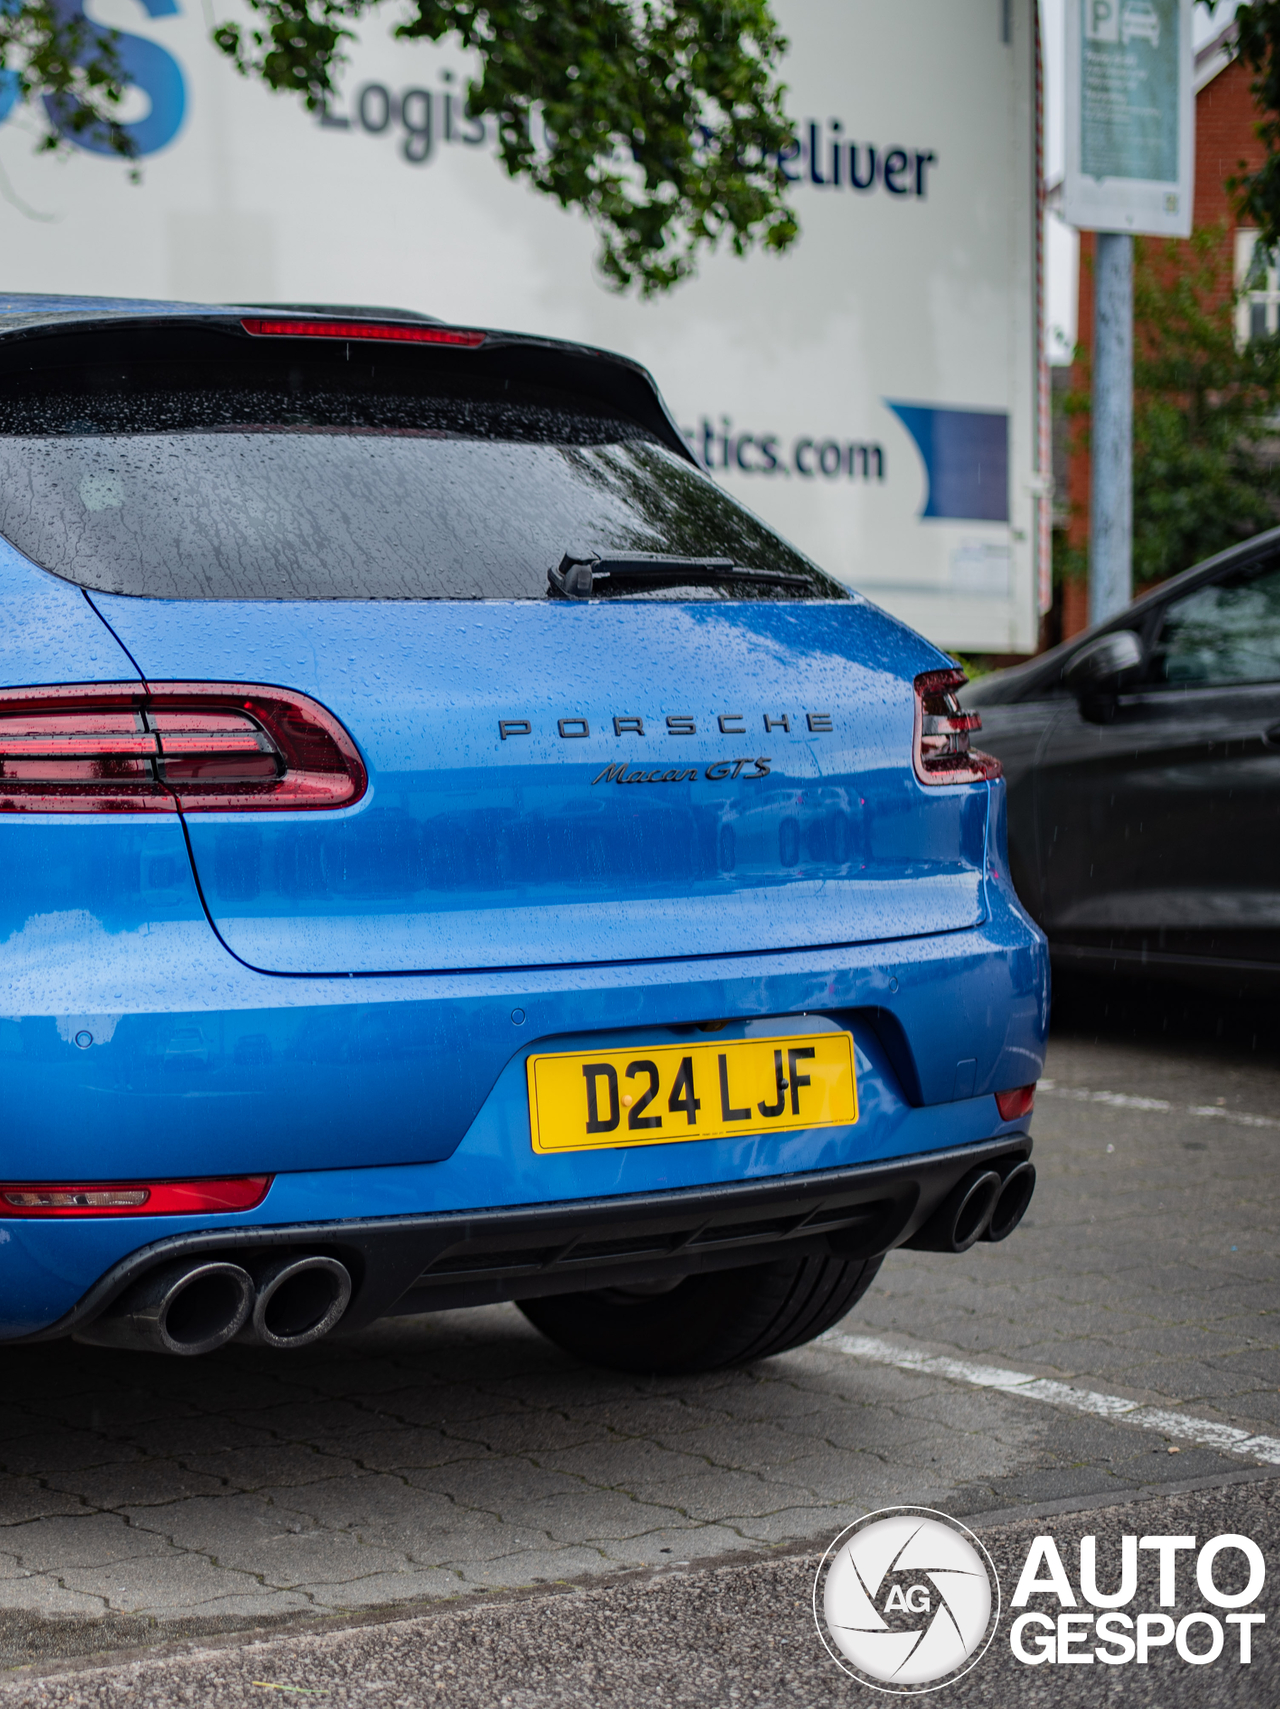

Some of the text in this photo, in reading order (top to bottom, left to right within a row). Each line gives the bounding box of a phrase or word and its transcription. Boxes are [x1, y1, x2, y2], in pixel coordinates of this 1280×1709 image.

[498, 713, 834, 741] PORSCHE
[591, 757, 772, 786] Macan GTS
[581, 1046, 816, 1135] D24 LJF
